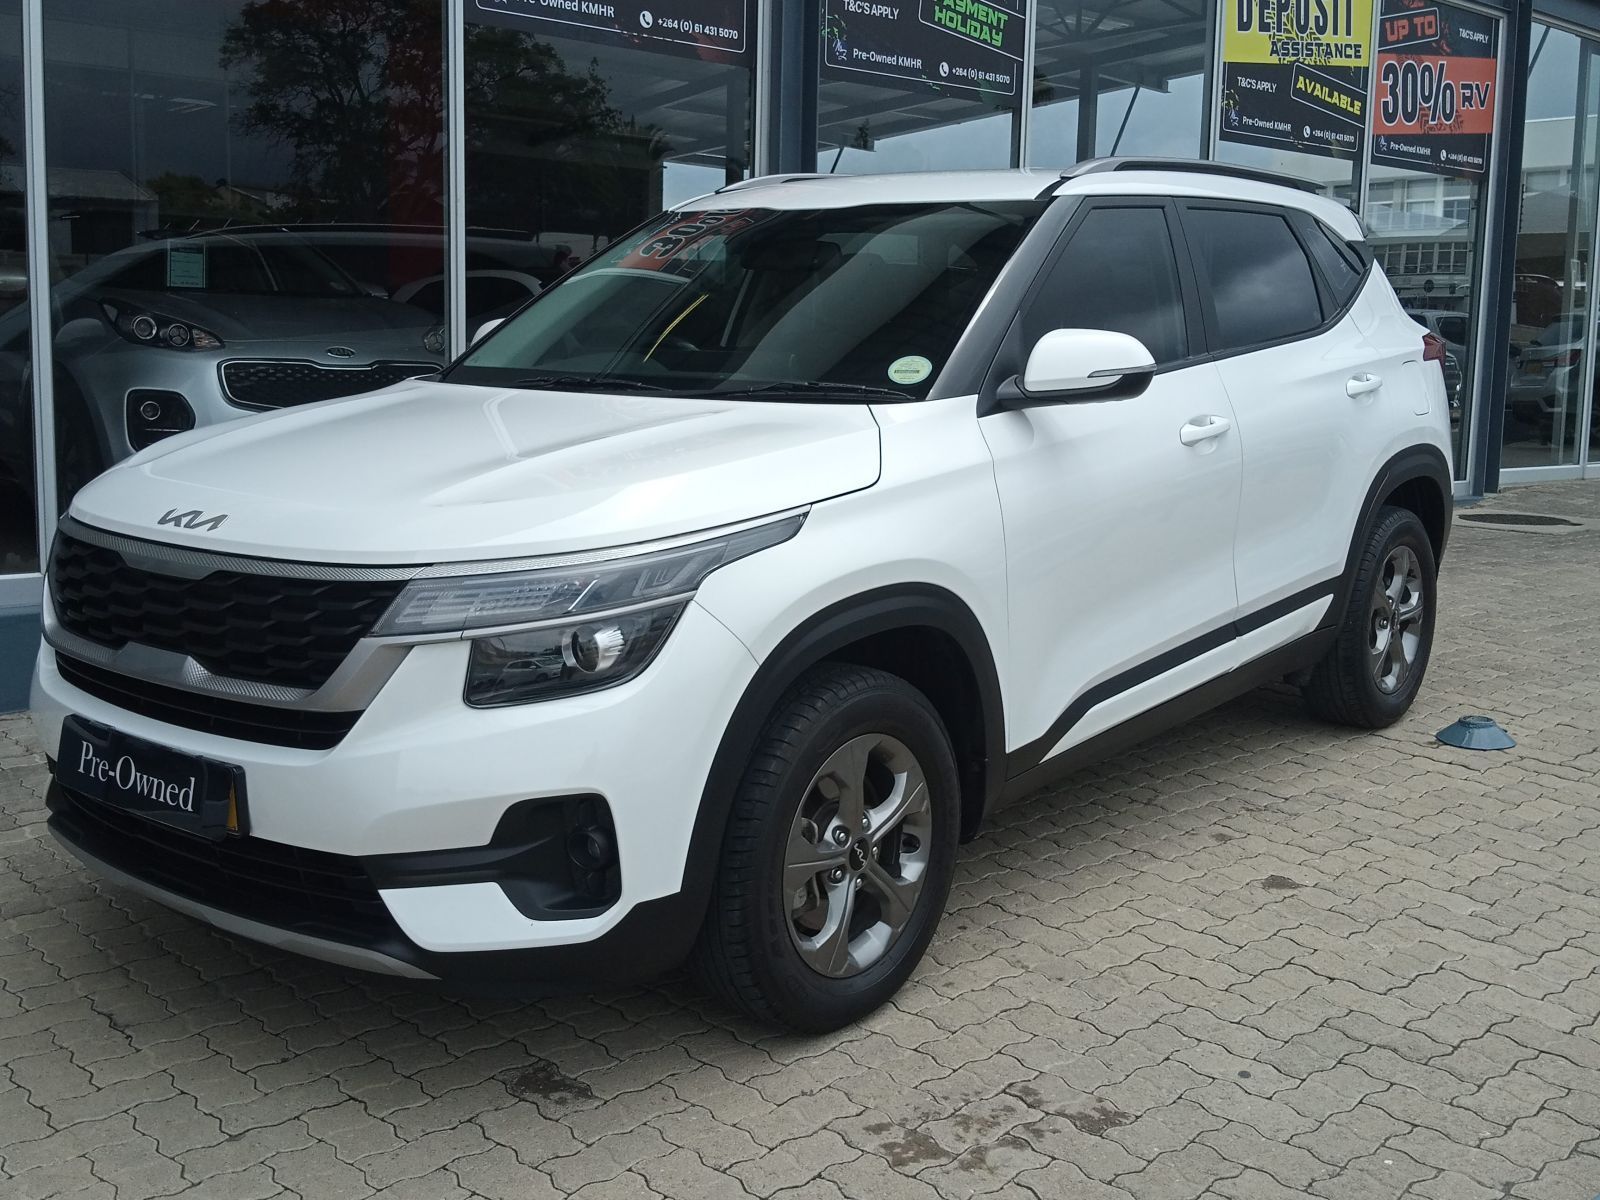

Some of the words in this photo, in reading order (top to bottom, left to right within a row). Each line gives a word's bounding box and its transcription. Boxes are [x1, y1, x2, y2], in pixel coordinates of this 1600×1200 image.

[581, 2, 615, 18] KMHR
[871, 4, 899, 20] APPLY
[934, 0, 1009, 30] AYMENT
[657, 17, 679, 30] +264
[680, 19, 693, 34] (0)
[694, 23, 703, 34] 61
[703, 25, 718, 36] 431
[718, 27, 739, 40] 5070
[934, 5, 1003, 47] HOLIDAY
[1384, 19, 1409, 42] UP
[1413, 15, 1436, 37] TO
[1473, 31, 1489, 44] APPLY
[853, 48, 897, 65] Pre-Owned
[898, 55, 922, 70] KMHR
[1269, 40, 1362, 59] ASSISTANCE
[1237, 76, 1257, 89] T&C'S
[1256, 80, 1277, 93] APPLY
[1296, 75, 1362, 116] AVAILABLE
[1381, 60, 1456, 126] 30%
[1460, 81, 1491, 110] RV
[1242, 116, 1274, 130] Pre-Owned
[1274, 121, 1292, 133] KMHR
[77, 740, 196, 813] Pre-Owned
